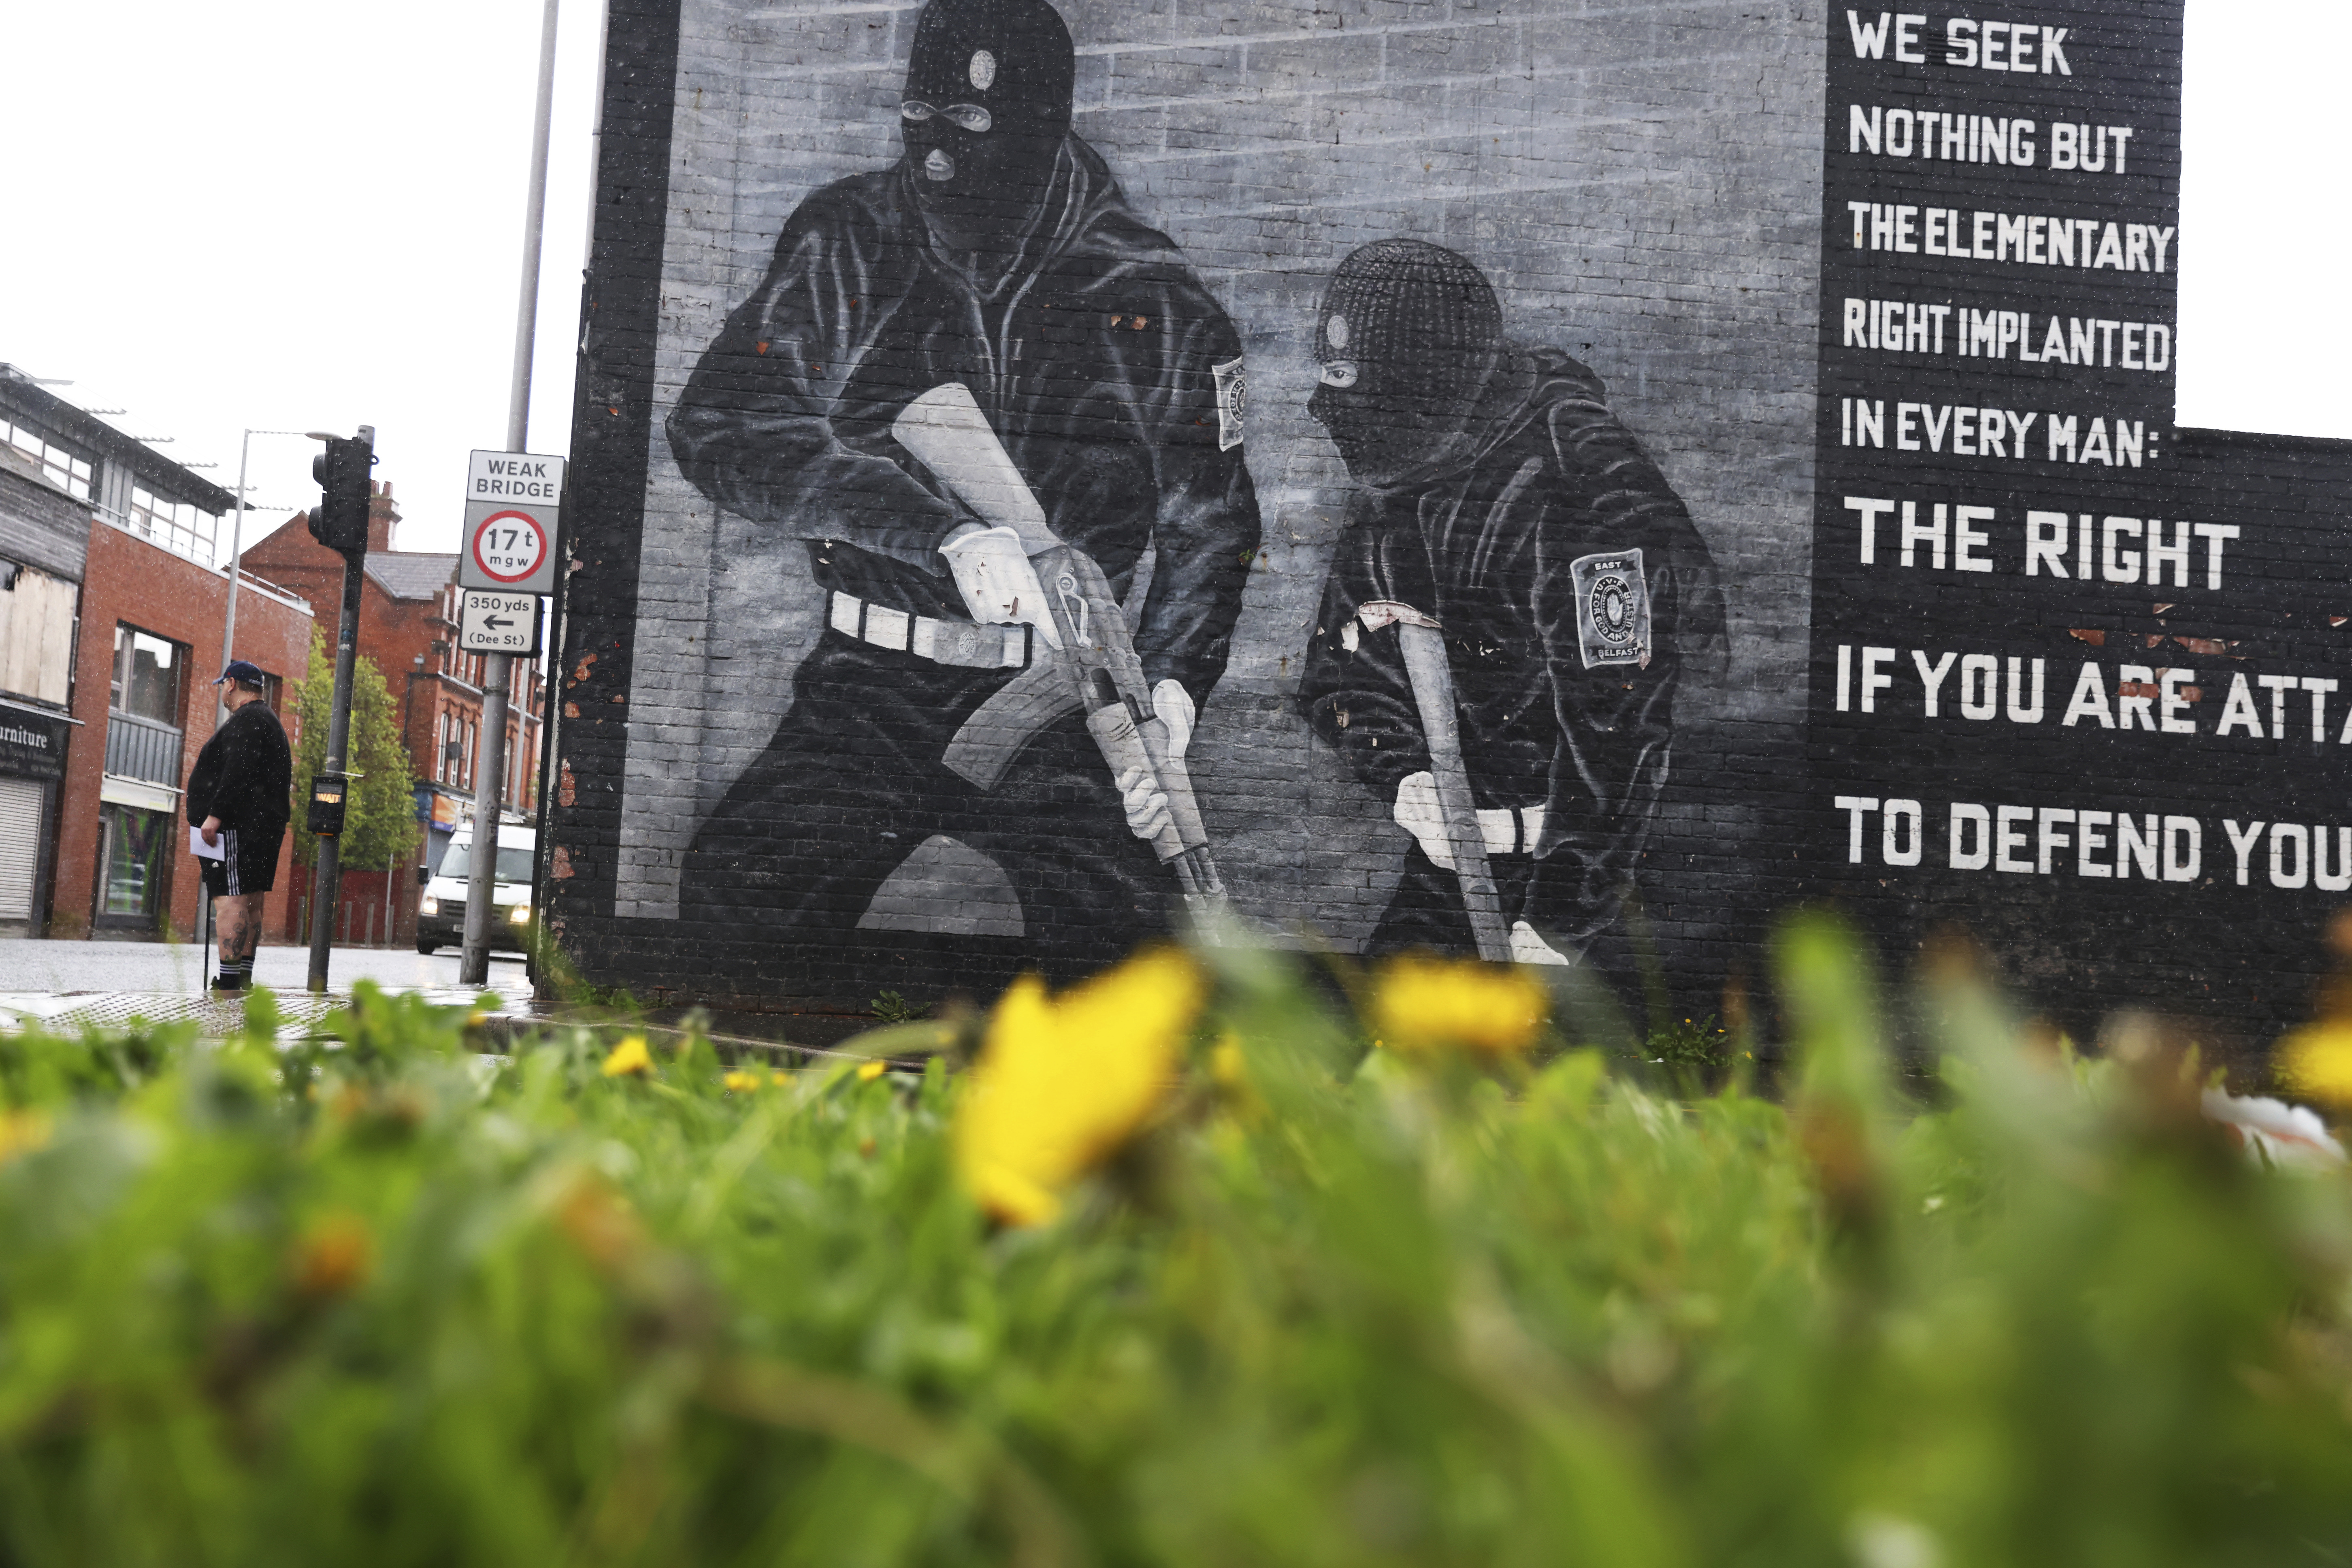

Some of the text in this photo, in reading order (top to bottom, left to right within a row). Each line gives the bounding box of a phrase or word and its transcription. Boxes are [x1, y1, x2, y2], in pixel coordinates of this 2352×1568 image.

[1847, 10, 2071, 75] WE SEEK
[1849, 104, 2133, 174] NOTHING BUT
[1848, 201, 2175, 273] THE ELEMENTARY
[1844, 297, 2170, 371] RIGHT IMPLANTED
[1842, 398, 2159, 467] IN EVERY MAN:
[488, 460, 546, 478] WEAK
[477, 479, 554, 497] BRIDGE
[1844, 496, 2240, 590] THE RIGHT
[1595, 561, 1621, 571] EAST
[470, 597, 529, 612] 350 yds
[1592, 593, 1600, 615] FOR
[1623, 592, 1634, 628] ULSTER
[470, 632, 524, 647] (Dee St)
[1595, 616, 1609, 634] GOD
[1598, 648, 1638, 657] BELFAST
[1836, 645, 1895, 713] IF
[1911, 650, 2045, 724] YOU
[2062, 662, 2196, 734] ARE
[317, 793, 341, 803] WAIT
[1834, 795, 1922, 866] TO
[1949, 802, 2201, 882] DEFEND
